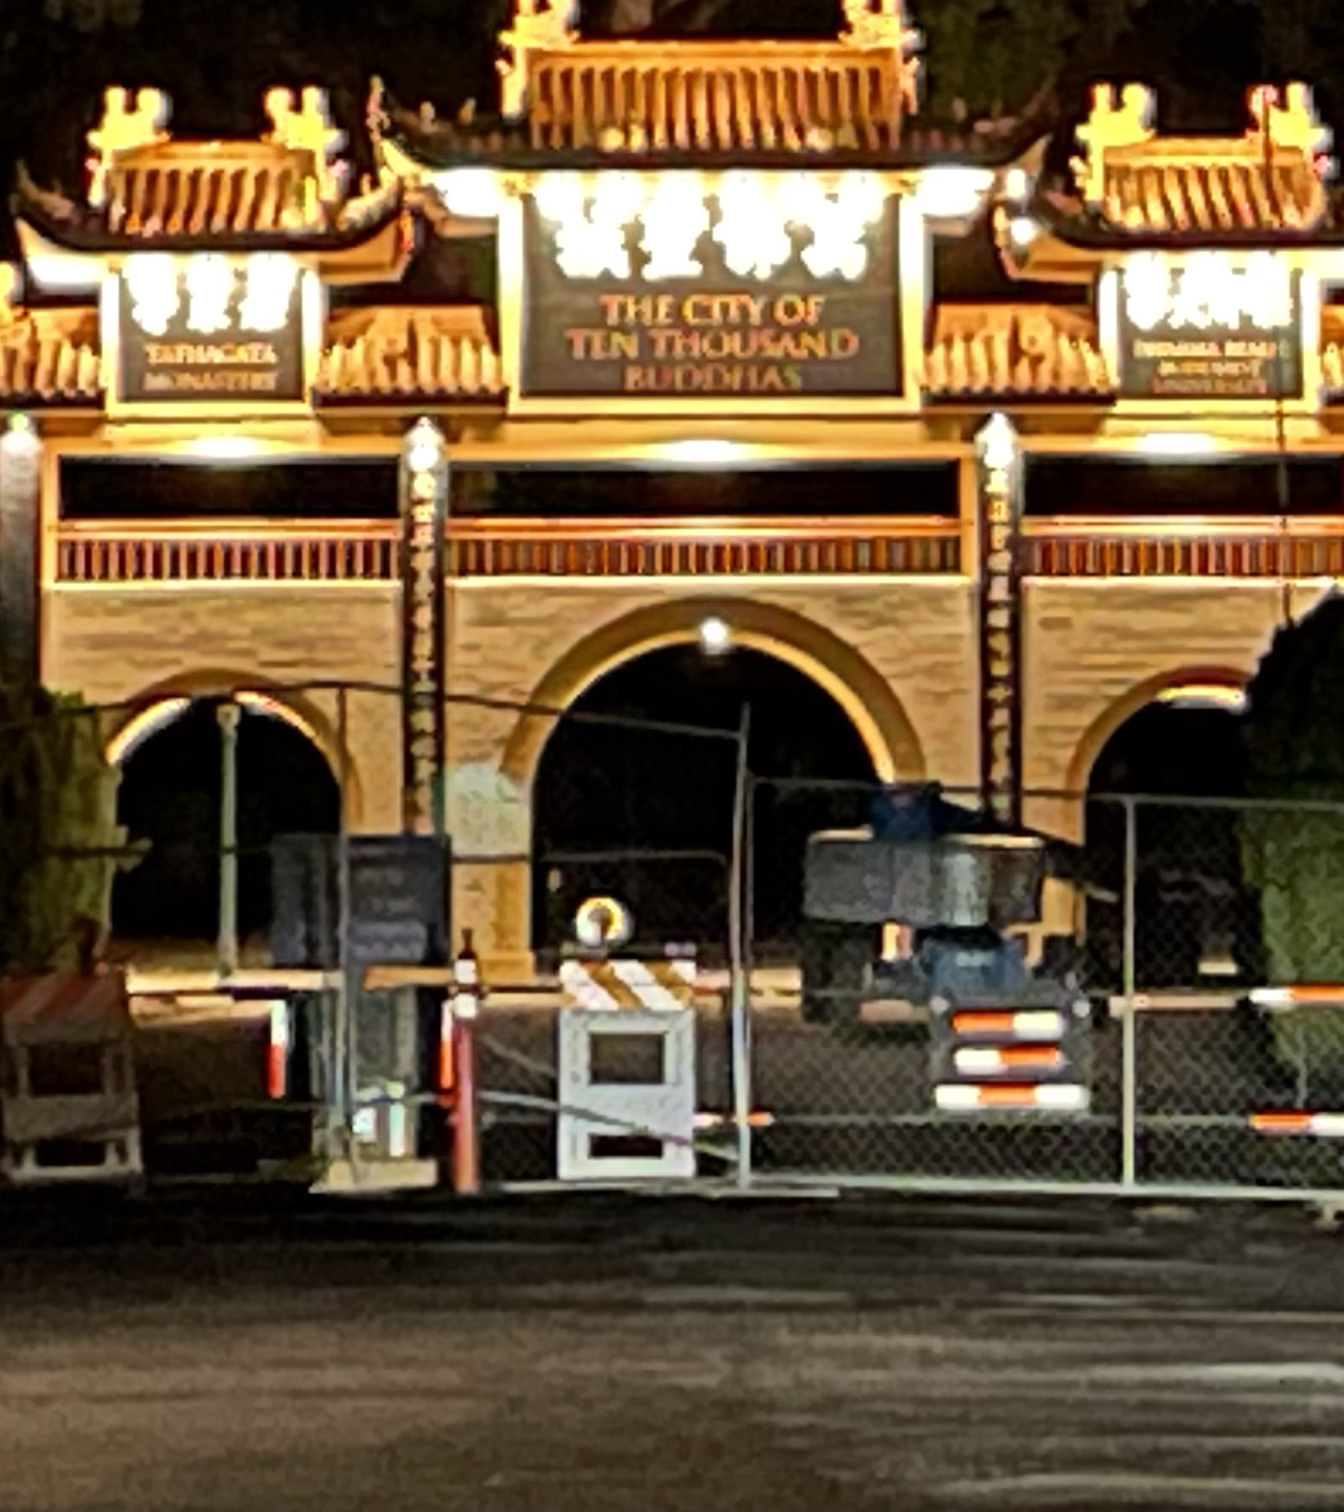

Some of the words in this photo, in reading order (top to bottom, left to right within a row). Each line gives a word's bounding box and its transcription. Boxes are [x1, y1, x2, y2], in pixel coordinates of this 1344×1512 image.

[600, 294, 674, 327] THE
[681, 294, 767, 325] CITY
[773, 293, 827, 325] OF
[566, 329, 639, 361] TEN
[648, 329, 860, 361] THOUSAND
[623, 365, 804, 392] BUDDHAS
